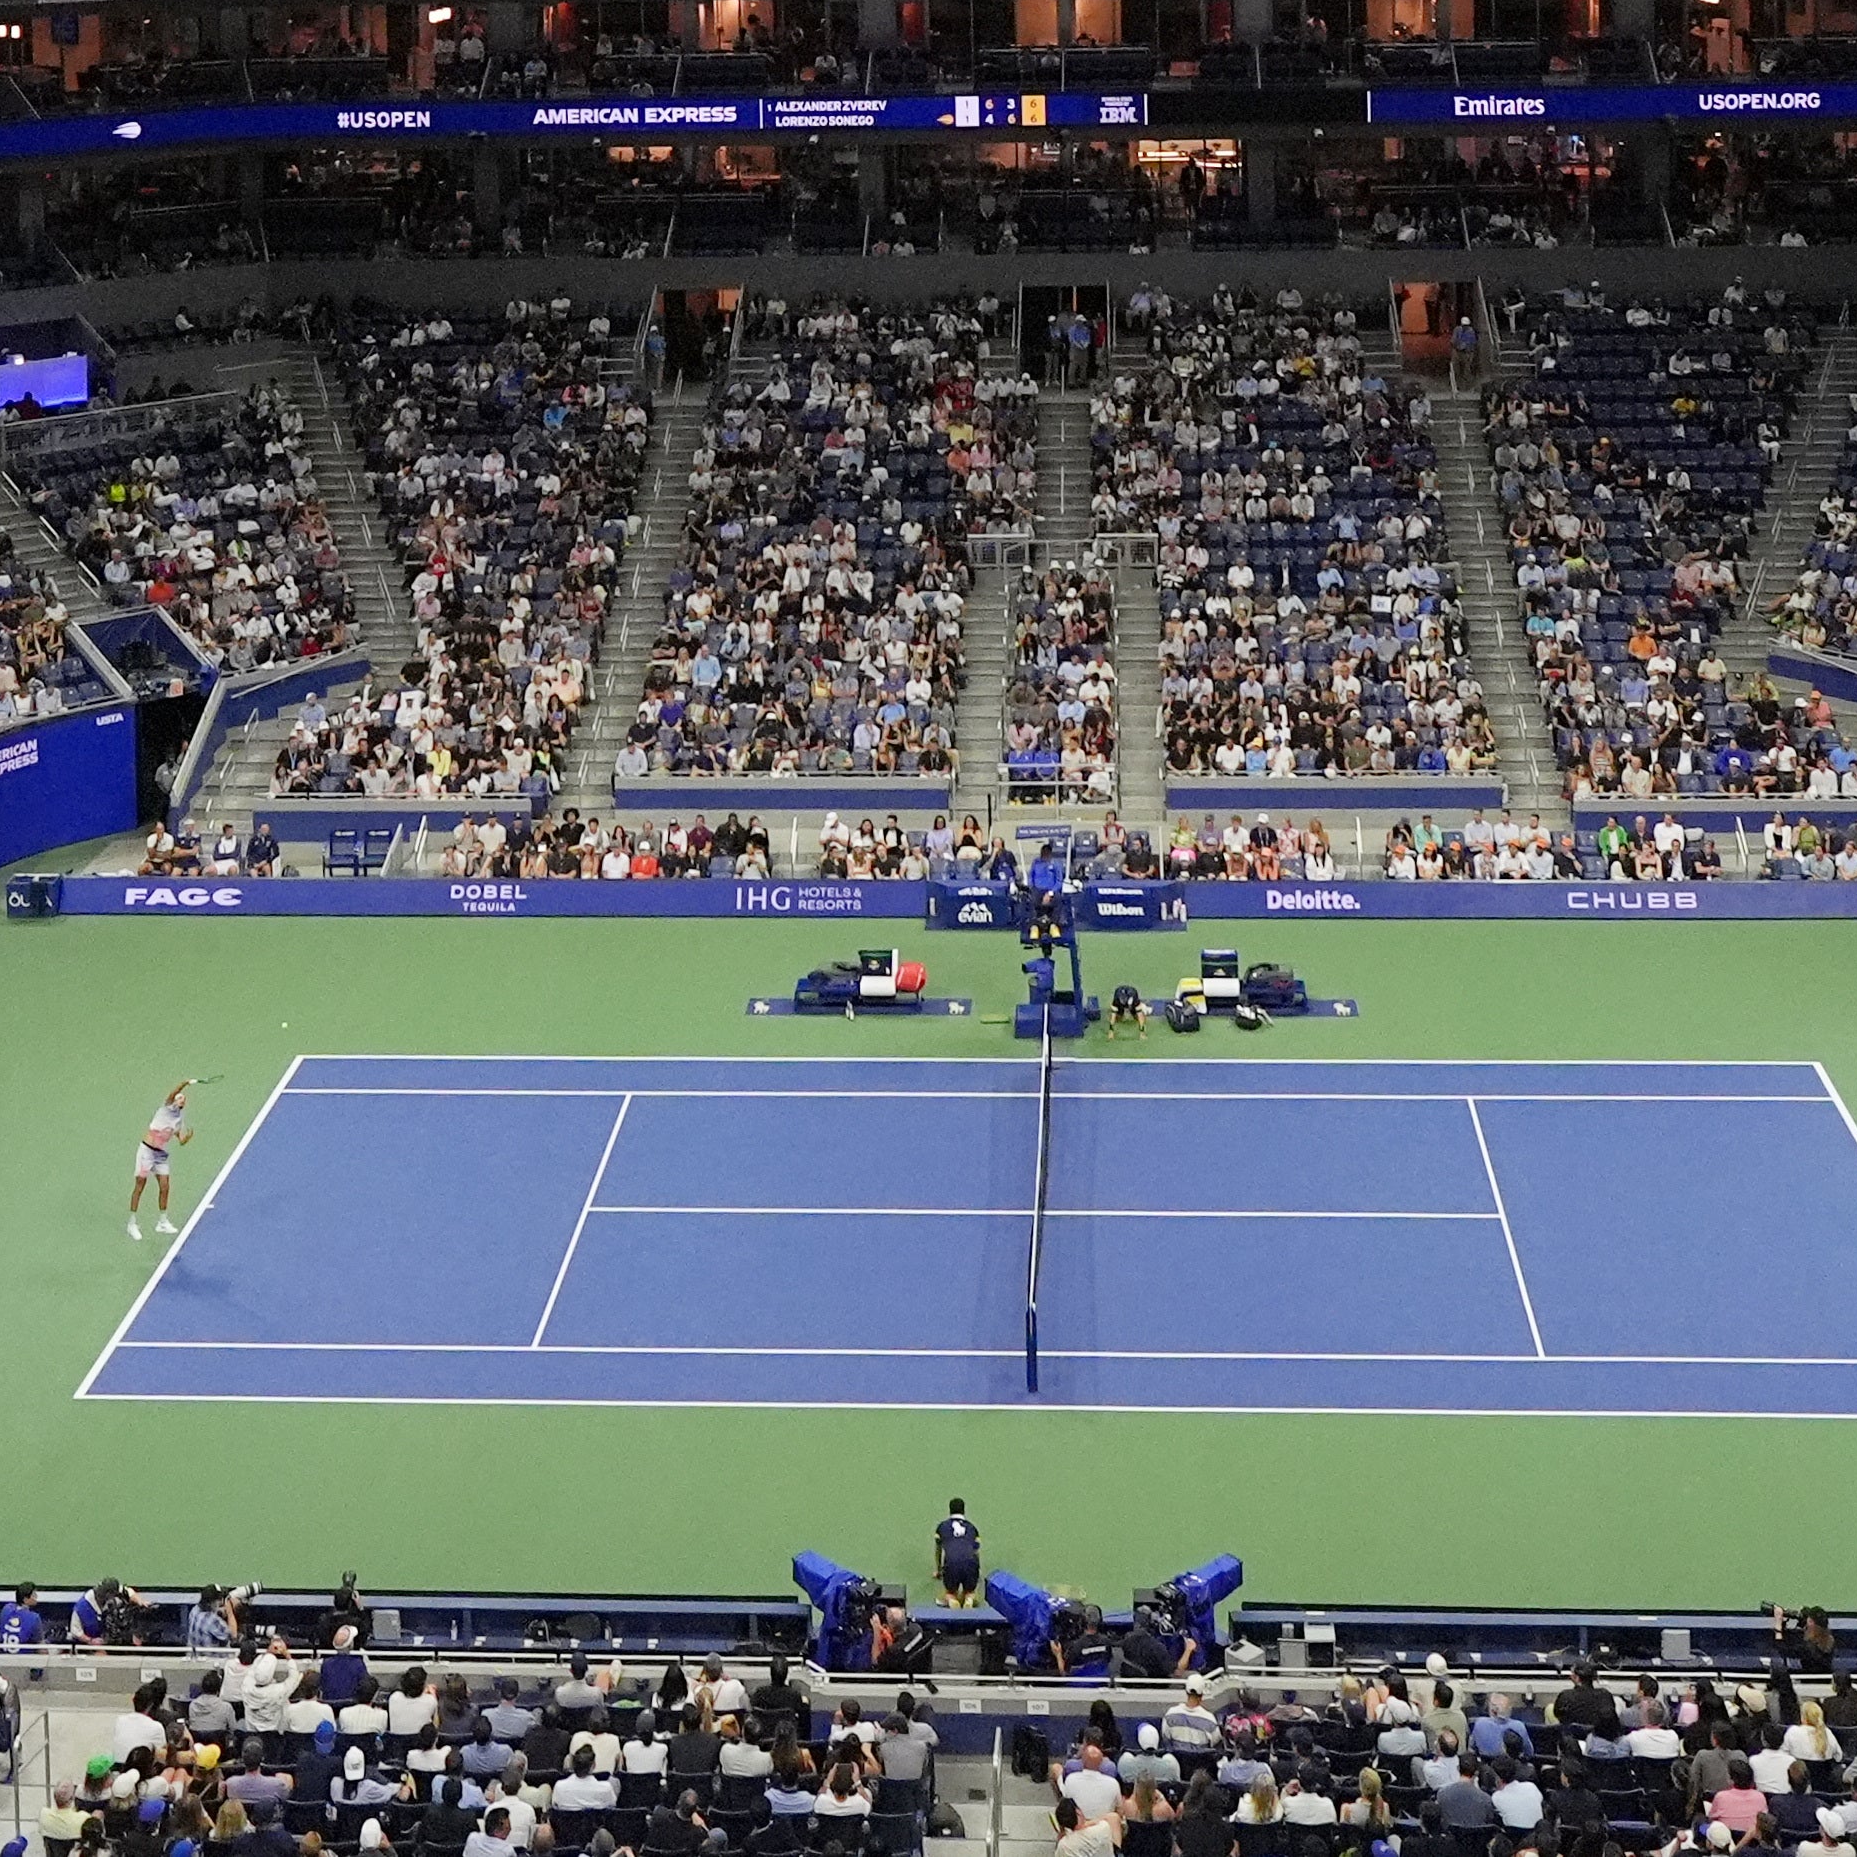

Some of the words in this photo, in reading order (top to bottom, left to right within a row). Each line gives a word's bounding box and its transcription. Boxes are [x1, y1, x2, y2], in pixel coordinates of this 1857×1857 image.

[775, 101, 841, 112] ALEXANDER
[842, 100, 888, 112] ZVEREV
[985, 99, 994, 110] 6
[1007, 98, 1016, 110] 3
[1030, 99, 1037, 109] 6
[1453, 95, 1546, 116] Emirates
[1698, 92, 1821, 111] USOPEN.ORG
[337, 110, 431, 129] #USOPEN
[533, 107, 639, 125] AMERICAN
[644, 106, 738, 124] EXPRESS
[775, 116, 828, 127] LORENZO
[829, 115, 875, 127] SONEGO
[985, 113, 995, 125] 4
[1007, 113, 1017, 125] 6
[1030, 114, 1038, 124] 6
[1099, 107, 1139, 124] IBM
[95, 712, 124, 726] USTA
[124, 887, 243, 906] FAGE
[450, 884, 527, 900] DOBEL
[736, 886, 791, 911] IHG
[798, 887, 851, 898] HOTELS
[853, 887, 862, 898] &
[1266, 889, 1361, 910] Deloitte.
[462, 902, 516, 912] TEQUILA
[798, 899, 862, 911] RESORTS
[1567, 891, 1698, 909] CHUBB
[958, 909, 993, 923] evian
[1097, 902, 1145, 916] Wilson
